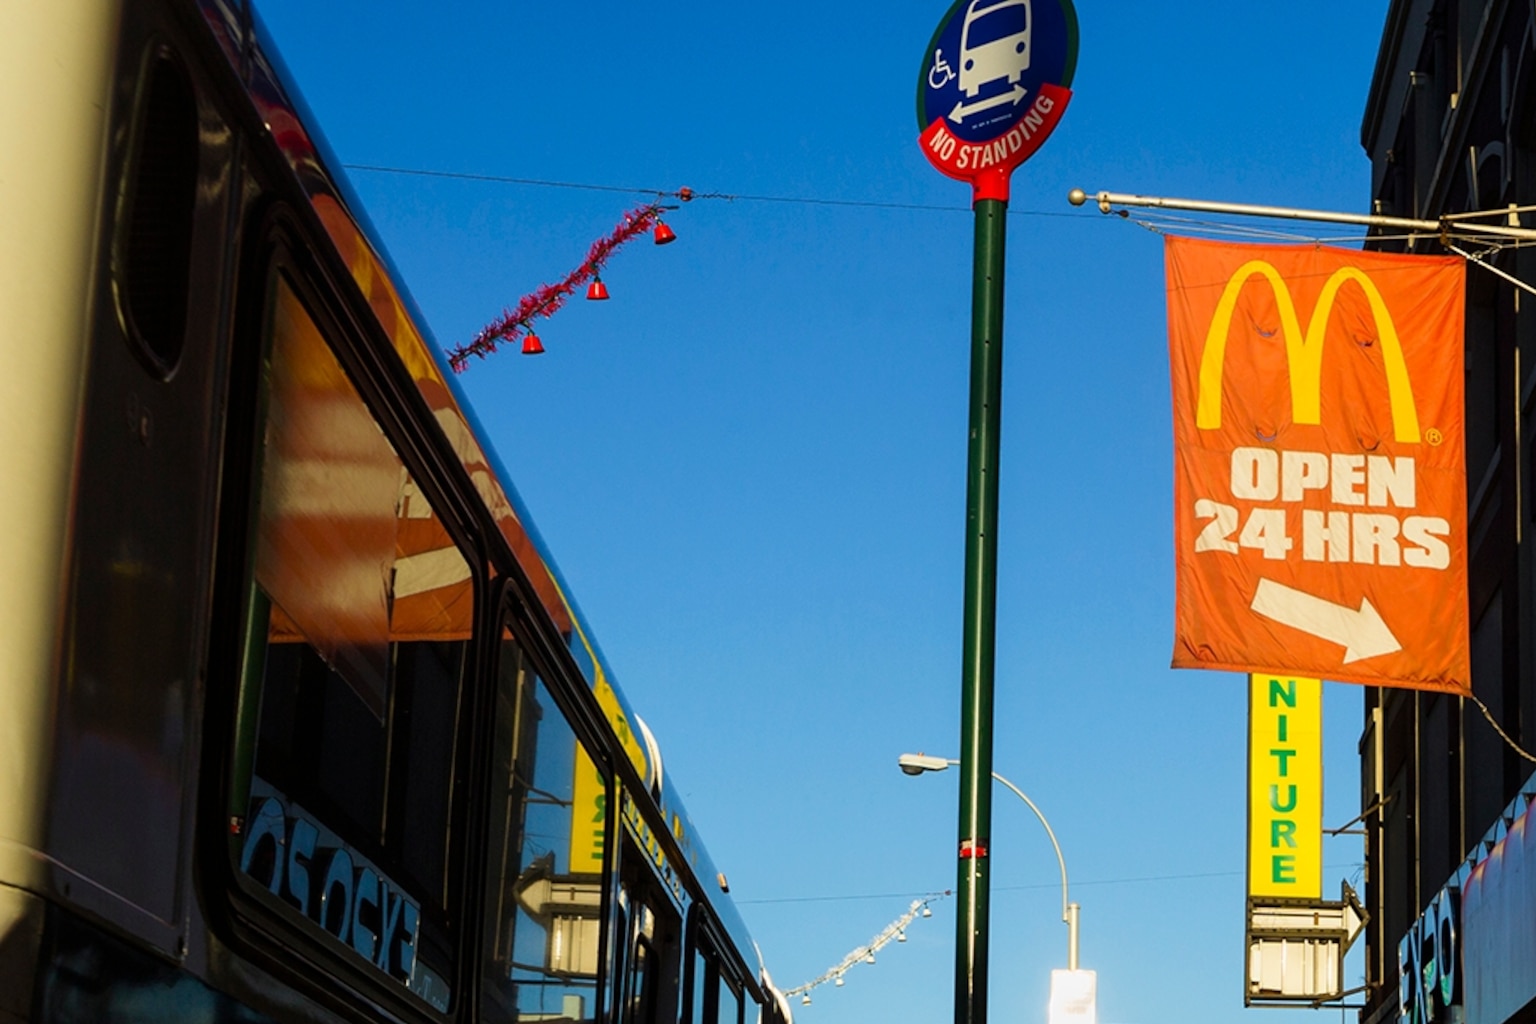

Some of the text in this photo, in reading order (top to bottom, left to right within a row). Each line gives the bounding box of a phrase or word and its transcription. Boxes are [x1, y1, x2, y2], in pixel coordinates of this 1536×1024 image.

[929, 95, 1055, 169] NO STANDING
[1230, 446, 1416, 508] OPEN
[1194, 499, 1451, 571] 24 HRS
